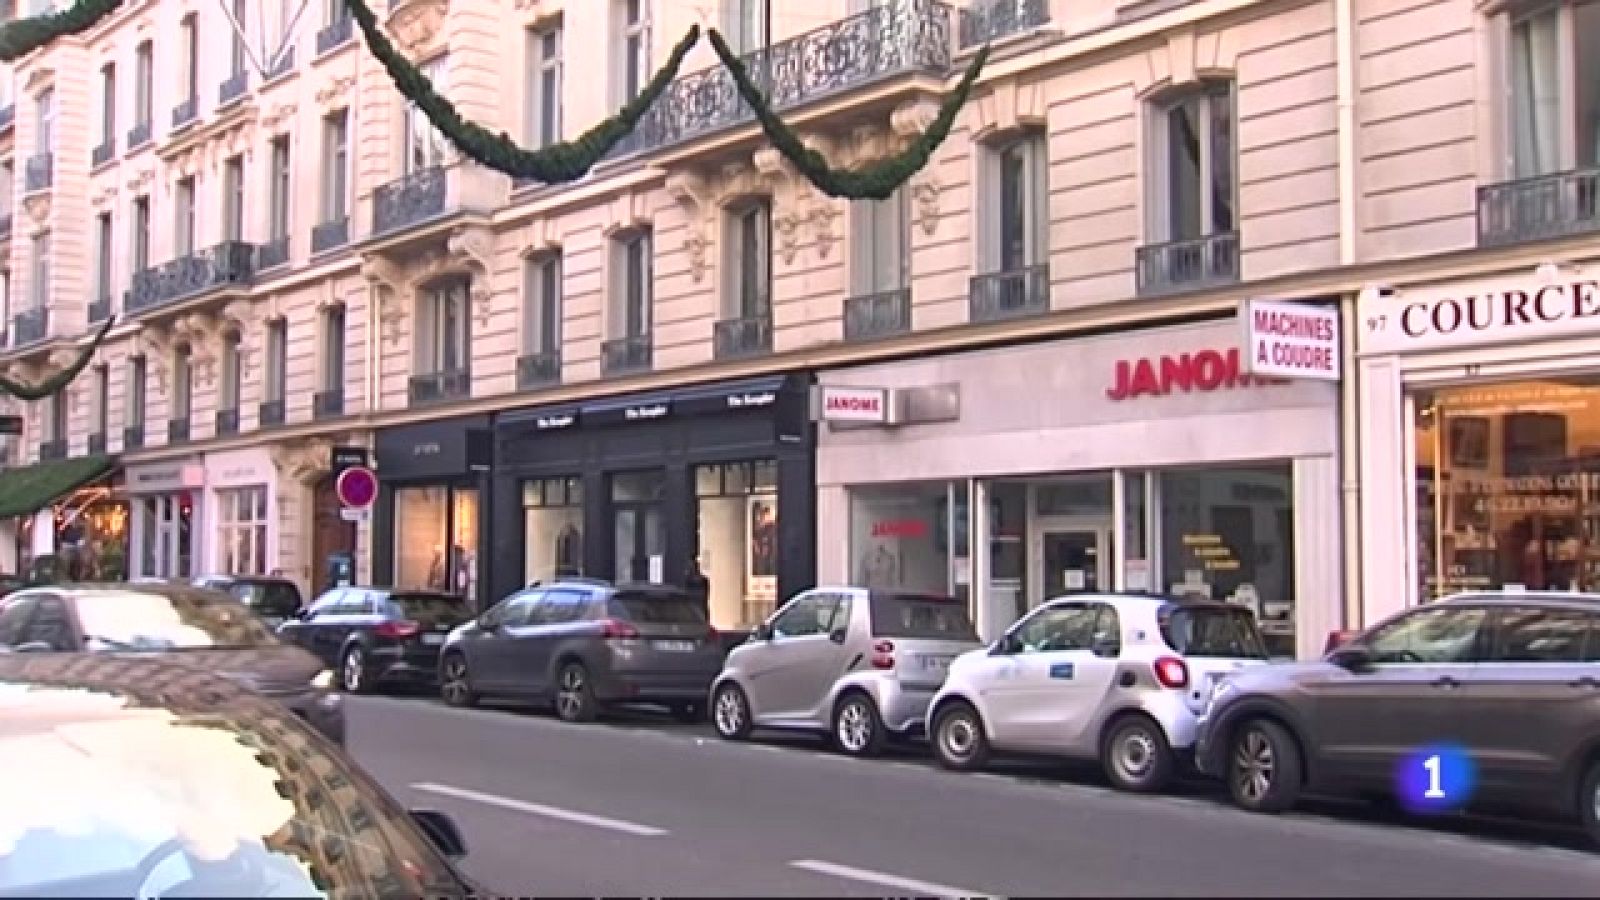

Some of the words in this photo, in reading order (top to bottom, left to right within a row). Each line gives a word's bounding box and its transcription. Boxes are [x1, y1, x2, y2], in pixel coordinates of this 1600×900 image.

[1400, 279, 1600, 338] COURCE
[1254, 309, 1334, 341] MACHINES
[1272, 342, 1334, 371] COUDRE
[826, 397, 879, 412] JANOME
